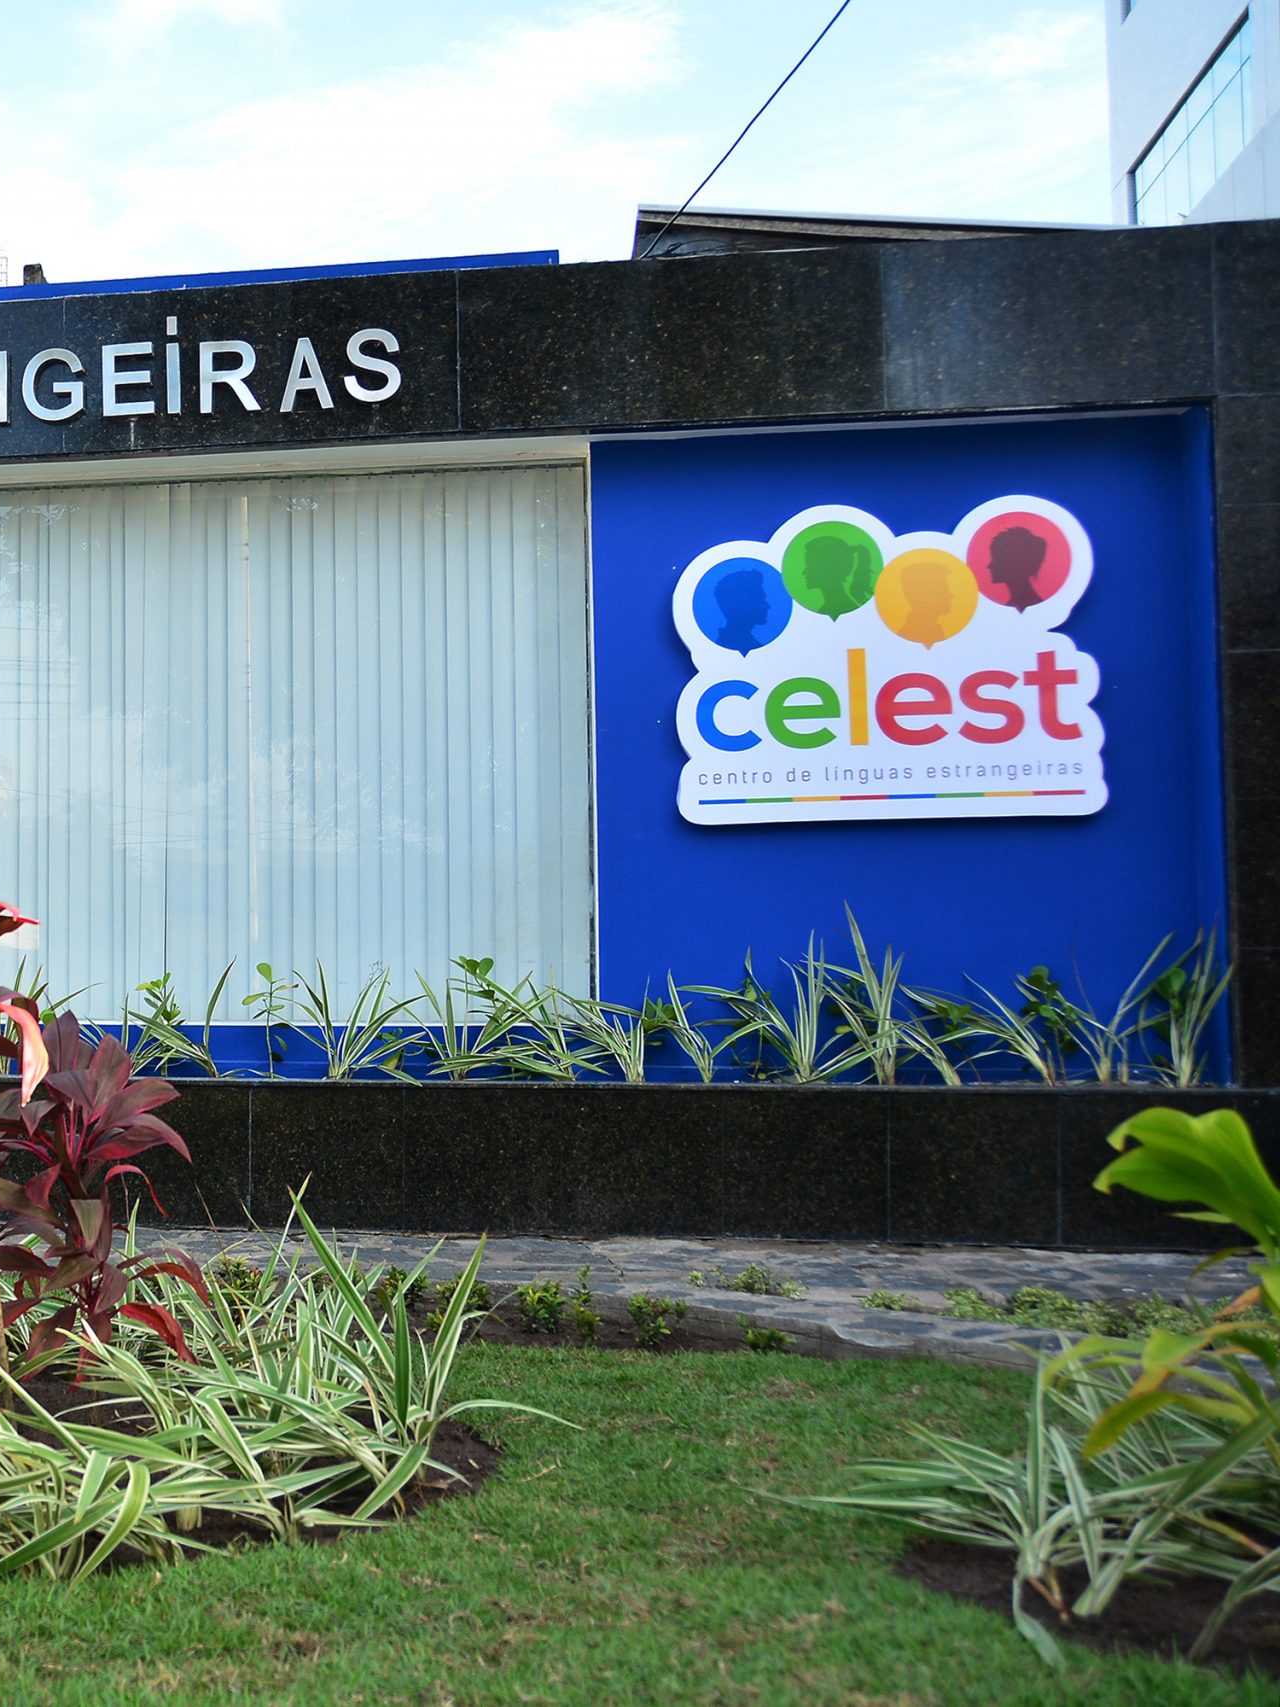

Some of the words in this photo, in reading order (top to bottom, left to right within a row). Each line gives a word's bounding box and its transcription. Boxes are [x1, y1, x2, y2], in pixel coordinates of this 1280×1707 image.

[695, 648, 1083, 752] celest
[698, 769, 773, 786] centro
[786, 767, 811, 783] de
[926, 760, 1083, 781] estrangeiras
